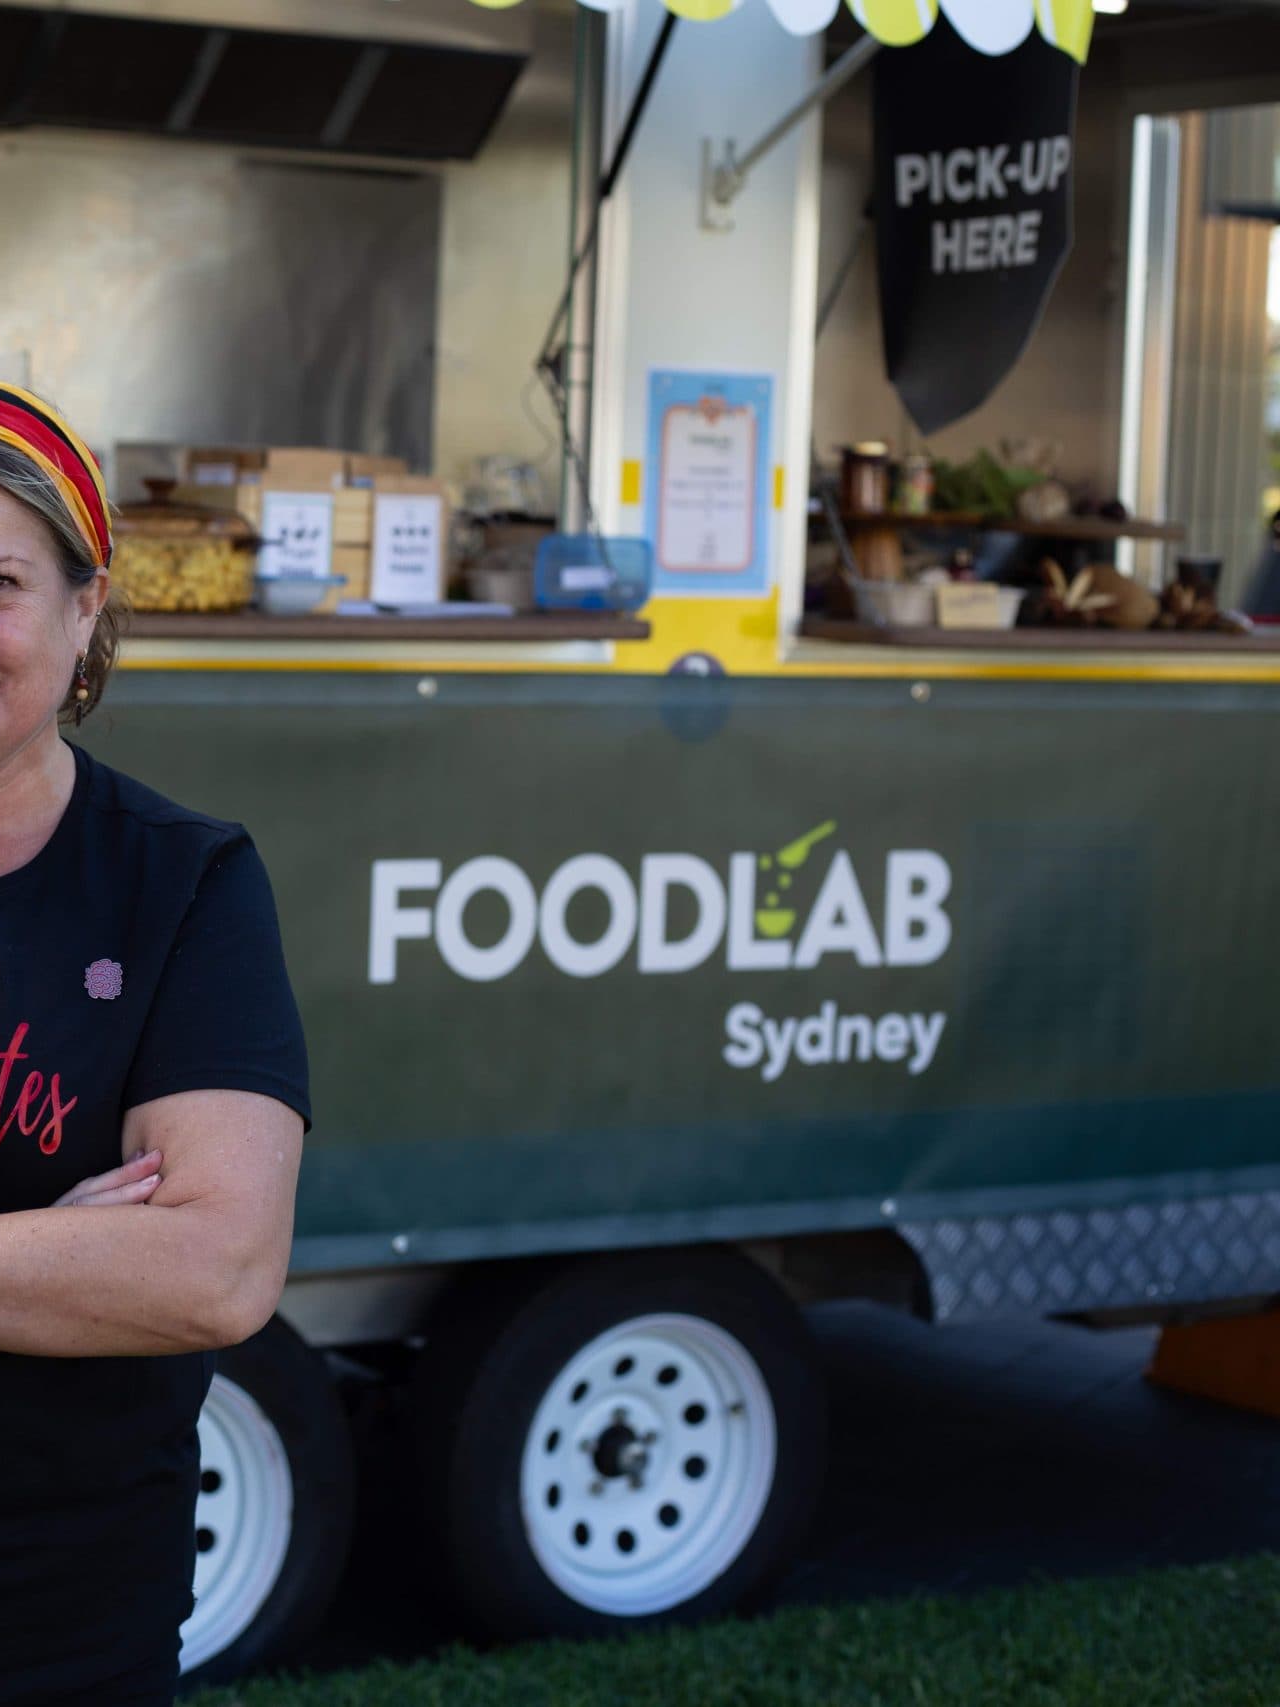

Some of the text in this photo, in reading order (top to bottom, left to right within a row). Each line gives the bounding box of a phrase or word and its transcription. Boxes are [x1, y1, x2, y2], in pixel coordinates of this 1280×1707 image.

[895, 134, 1071, 208] PICK-UP
[931, 210, 1043, 275] HERE
[368, 849, 953, 985] FOODLAB
[723, 1001, 946, 1083] Sydney
